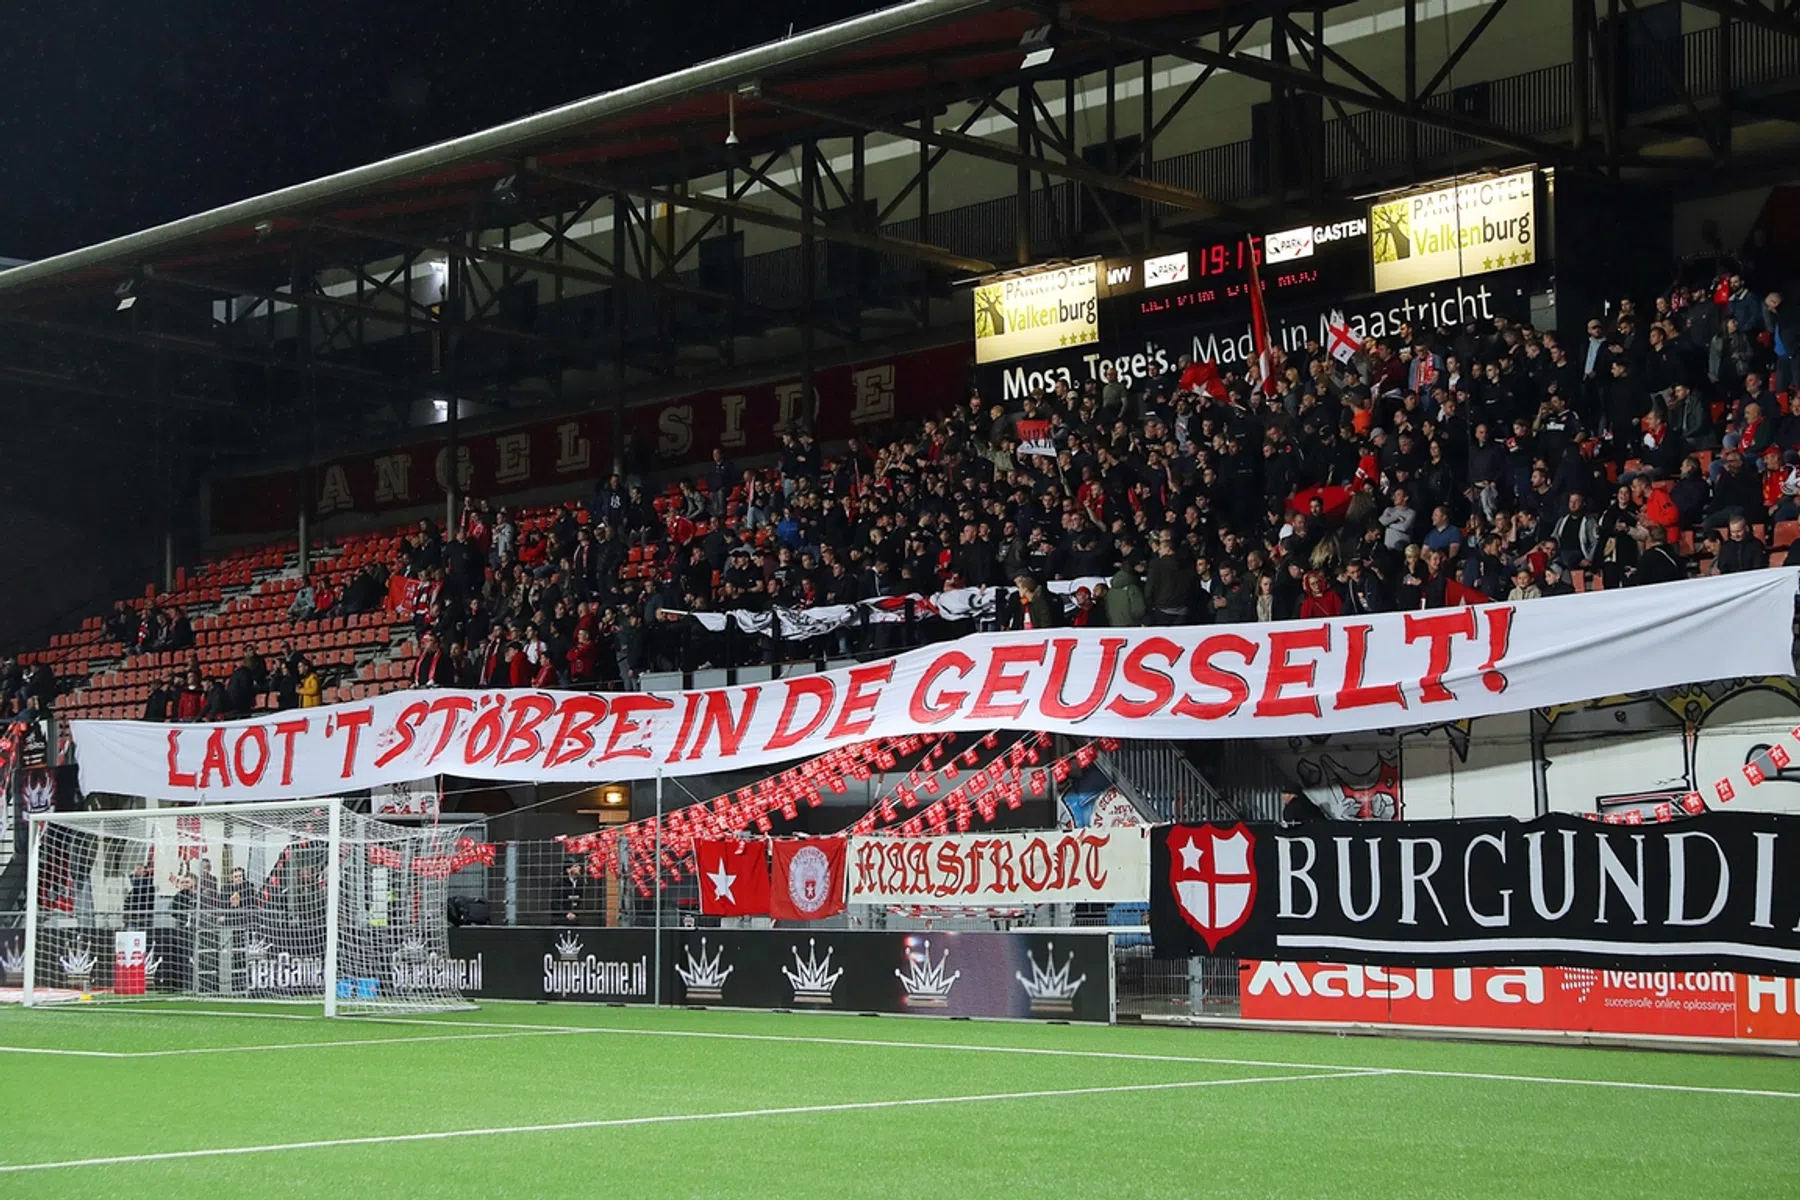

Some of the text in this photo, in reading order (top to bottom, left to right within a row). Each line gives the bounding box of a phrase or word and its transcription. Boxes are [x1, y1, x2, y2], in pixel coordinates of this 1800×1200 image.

[1414, 177, 1530, 219] PARKHOTEL
[1314, 218, 1367, 244] GASTEN
[1414, 212, 1531, 256] Valkenburg
[1007, 297, 1097, 333] Valkenburg
[1192, 324, 1256, 365] Mad
[1280, 319, 1308, 352] in
[317, 364, 896, 514] ANGEL SIDE
[168, 717, 310, 789] LAOT
[664, 687, 762, 763] IN
[763, 659, 897, 751] DE
[908, 606, 1516, 725] GEUSSELT!
[852, 833, 1112, 898] MAASFRONT
[1275, 829, 1800, 932] BURGUNDI
[543, 953, 647, 998] SuperGame.nl
[1655, 998, 1681, 1010] online
[1683, 999, 1736, 1014] oplossingen
